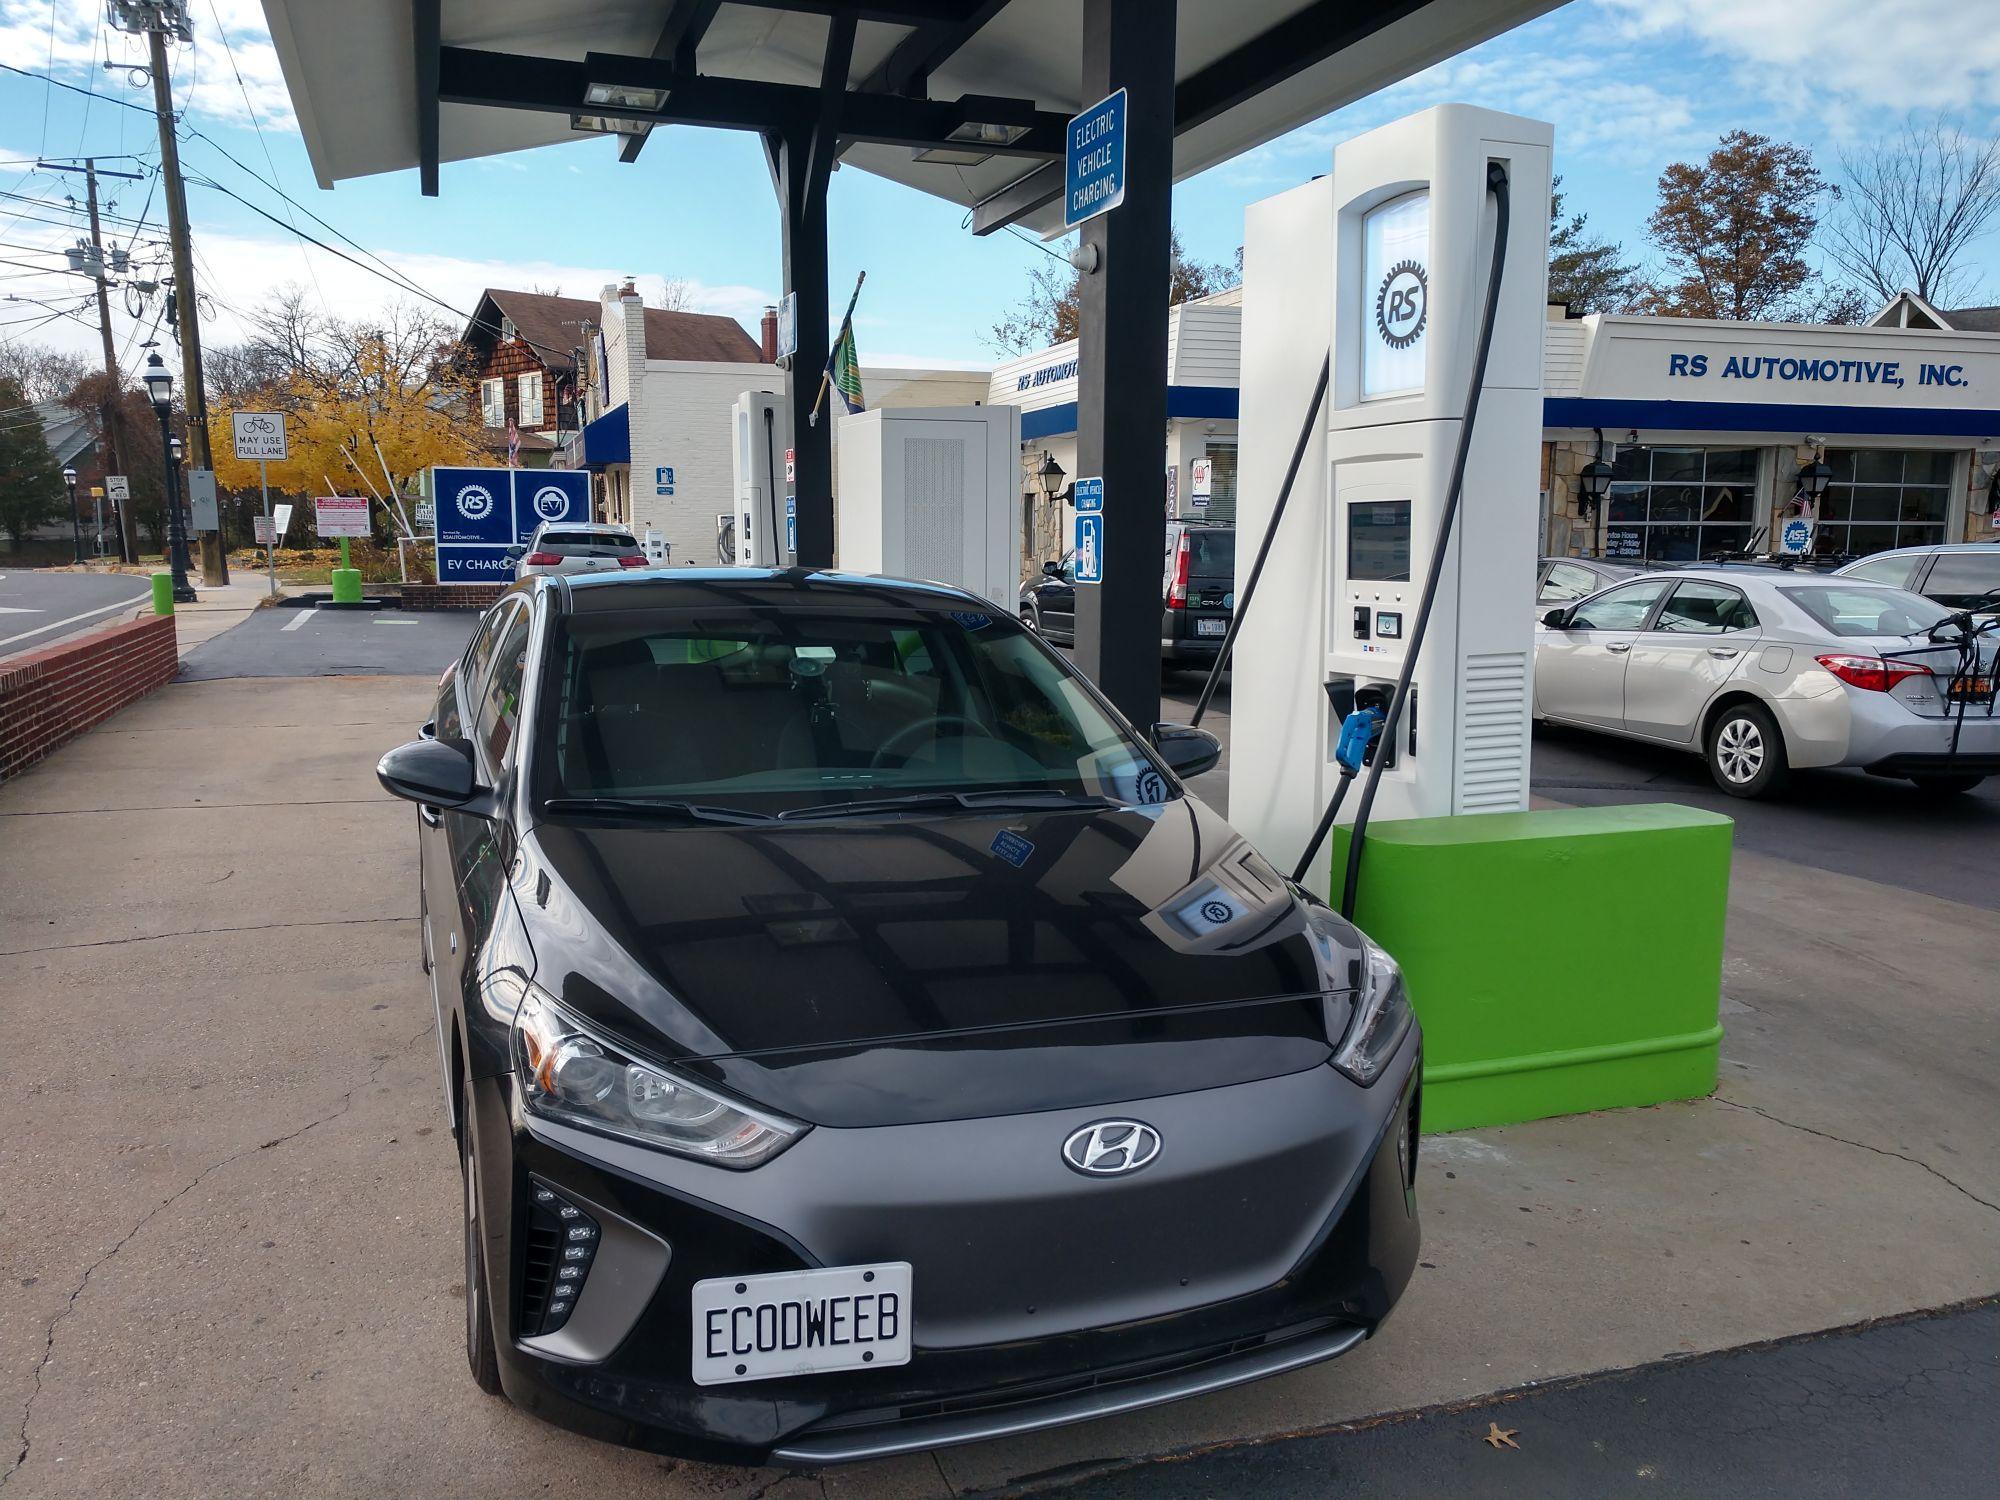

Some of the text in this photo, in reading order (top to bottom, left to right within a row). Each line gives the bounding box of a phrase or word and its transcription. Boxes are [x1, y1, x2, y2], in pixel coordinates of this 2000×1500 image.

[1076, 109, 1115, 149] ELECTRIC
[1077, 142, 1112, 178] VEHICLE
[1073, 173, 1115, 211] CHARGING
[1387, 286, 1419, 323] RS
[1017, 358, 1079, 391] RS AUTOMOT
[1668, 353, 1969, 389] RS AUTOMOTIVE, INC.
[238, 446, 284, 455] FULL LANE
[239, 436, 282, 445] MAY USE
[464, 495, 485, 510] RS
[447, 559, 513, 570] EV CHARG
[706, 1292, 899, 1359] ECODWEEB
